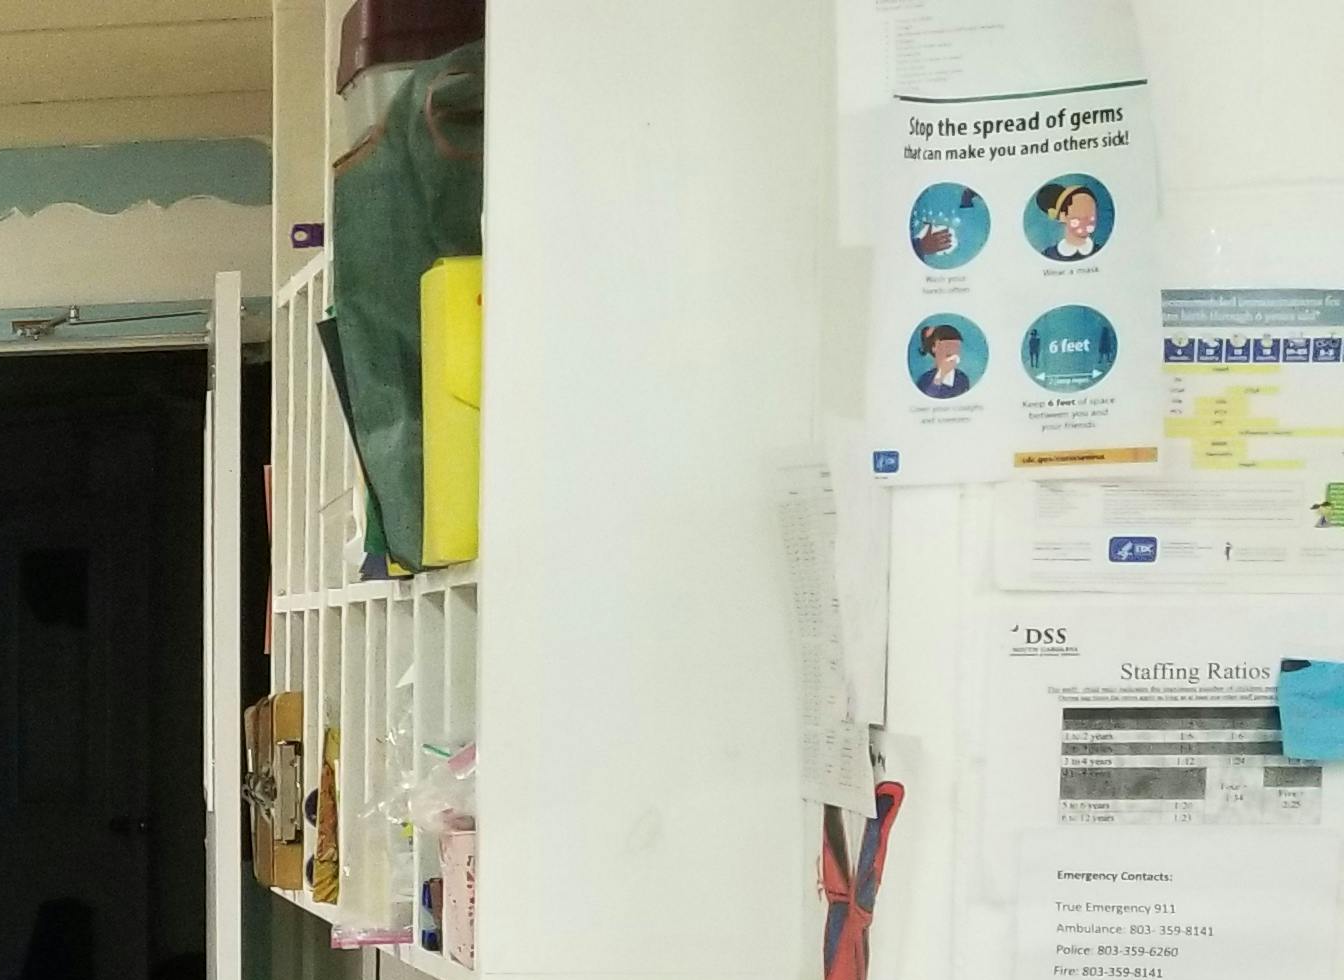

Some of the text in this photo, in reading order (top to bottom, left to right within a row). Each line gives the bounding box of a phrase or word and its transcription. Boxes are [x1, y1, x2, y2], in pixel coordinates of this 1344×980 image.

[909, 107, 1124, 140] Stop the spread of germs
[903, 130, 1130, 161] that can make you and others sick!
[1048, 338, 1090, 353] 6 feet
[1047, 399, 1055, 407] 6
[1056, 398, 1076, 407] feet
[1024, 628, 1068, 645] DSS
[1120, 661, 1271, 685] Staffing Ratios
[1057, 870, 1173, 883] Emergency Contacts:
[1056, 901, 1176, 915] True Emergency 911
[1056, 923, 1215, 937] Ambulance: 803- 359-8141
[1097, 945, 1180, 958] 803-359-6260
[1053, 965, 1164, 979] Fire: 803-359-8141
